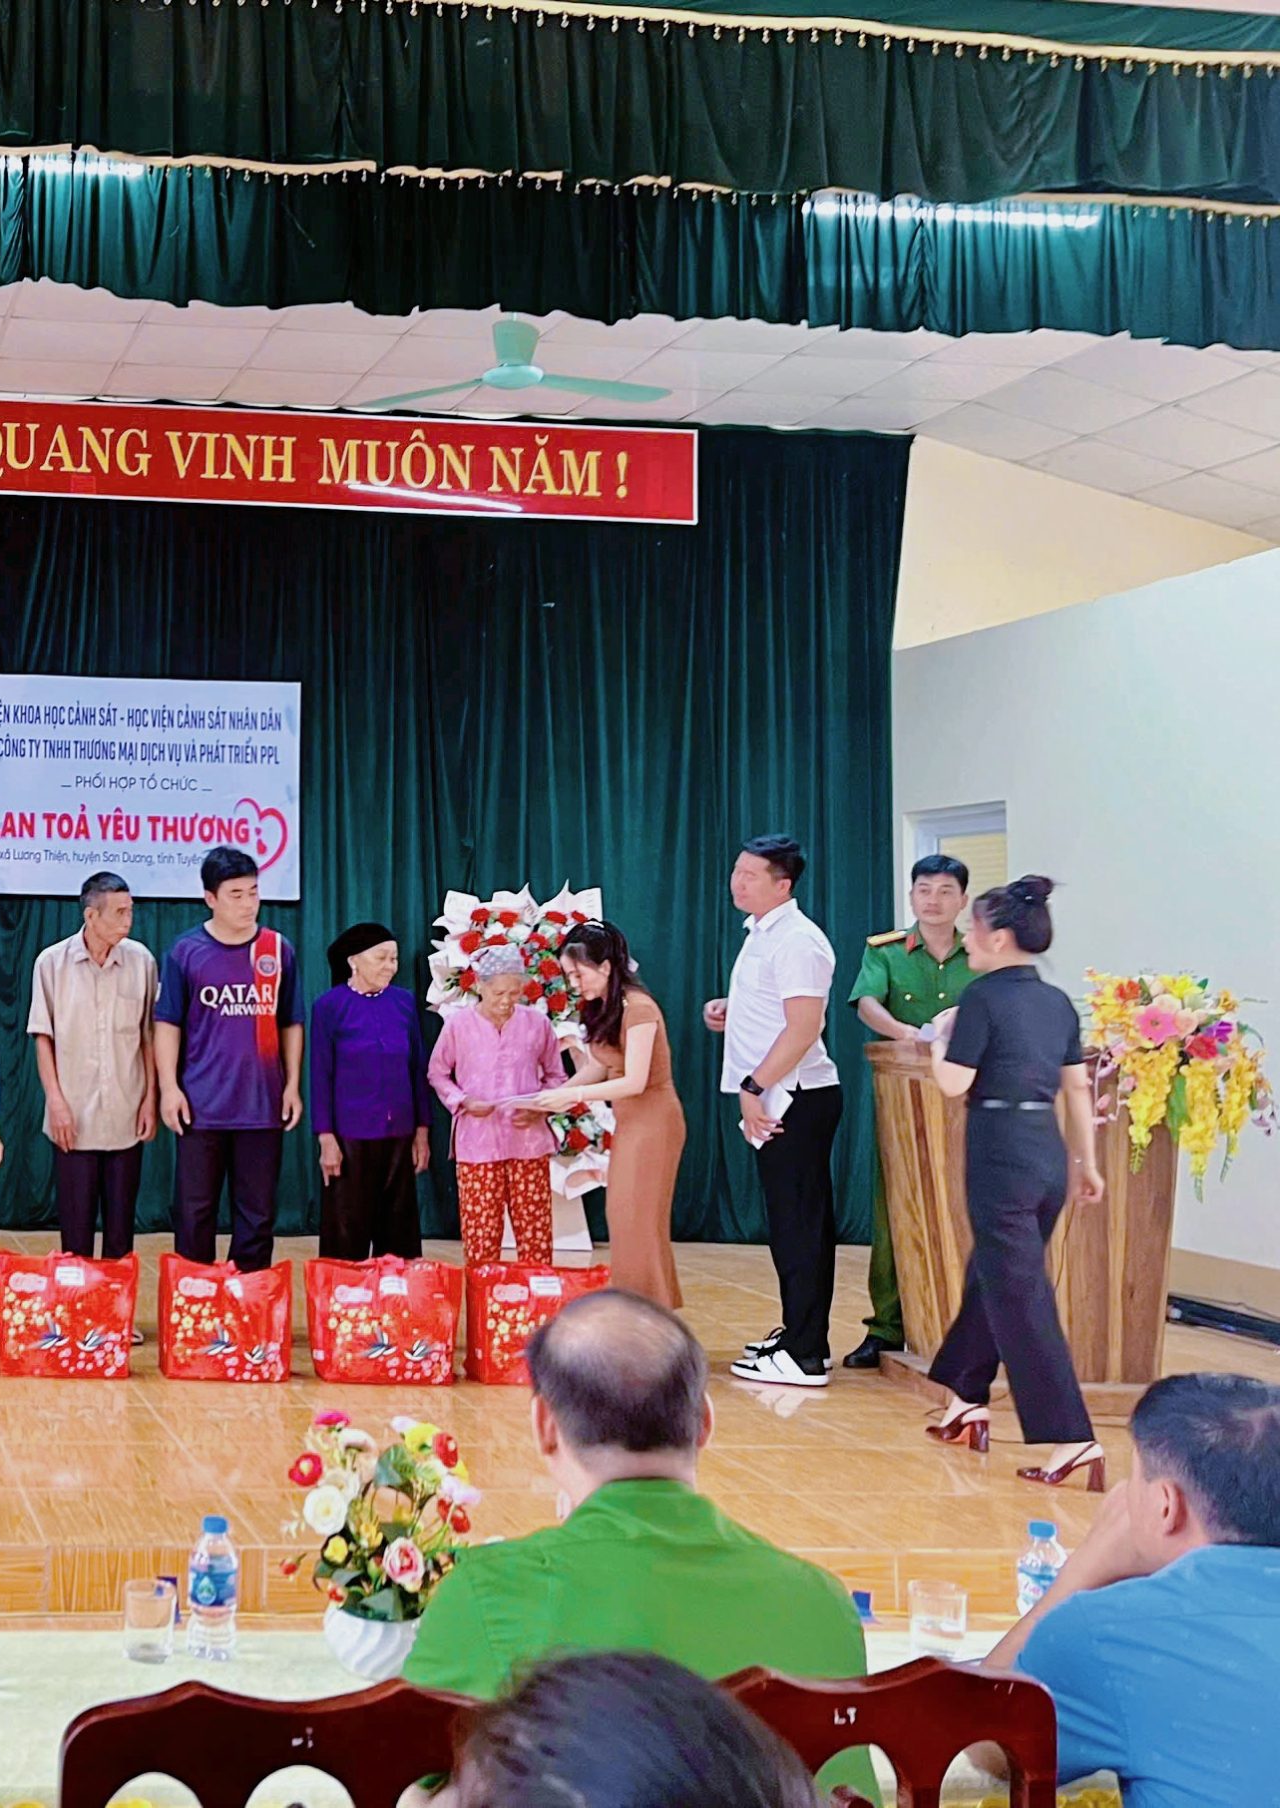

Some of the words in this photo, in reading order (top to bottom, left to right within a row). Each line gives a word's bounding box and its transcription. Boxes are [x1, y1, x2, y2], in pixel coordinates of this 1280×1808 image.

[165, 431, 296, 482] VINH
[318, 428, 475, 491] MUÔN
[487, 433, 603, 497] NĂM
[615, 450, 628, 498] !
[13, 704, 41, 724] KHOA
[44, 706, 65, 729] HỌC
[67, 700, 96, 726] CẢNH
[99, 702, 117, 726] SÁT
[127, 708, 149, 732] HỌC
[151, 704, 174, 733] VIỆN
[177, 703, 205, 729] CẢNH
[208, 706, 227, 730] SÁT
[229, 707, 258, 731] NHÂN
[260, 707, 282, 731] DÂN
[28, 738, 41, 758] TY
[43, 739, 71, 759] TNHH
[74, 739, 116, 760] THƯƠNG
[119, 741, 138, 766] MẠI
[141, 742, 165, 766] DỊCH
[168, 743, 182, 767] VỤ
[184, 739, 197, 763] VÀ
[199, 739, 226, 763] PHÁT
[228, 736, 258, 764] TRIỂN
[260, 746, 280, 765] PPL
[75, 772, 106, 789] PHỐI
[109, 776, 137, 793] HỢP
[160, 776, 198, 791] CHỨC
[42, 803, 90, 840] TOẢ
[97, 807, 140, 841] YÊU
[147, 813, 249, 844] THƯƠNG
[73, 851, 100, 865] huyện
[200, 984, 272, 1009] QATAR
[220, 1003, 275, 1016] AIRWAYS
